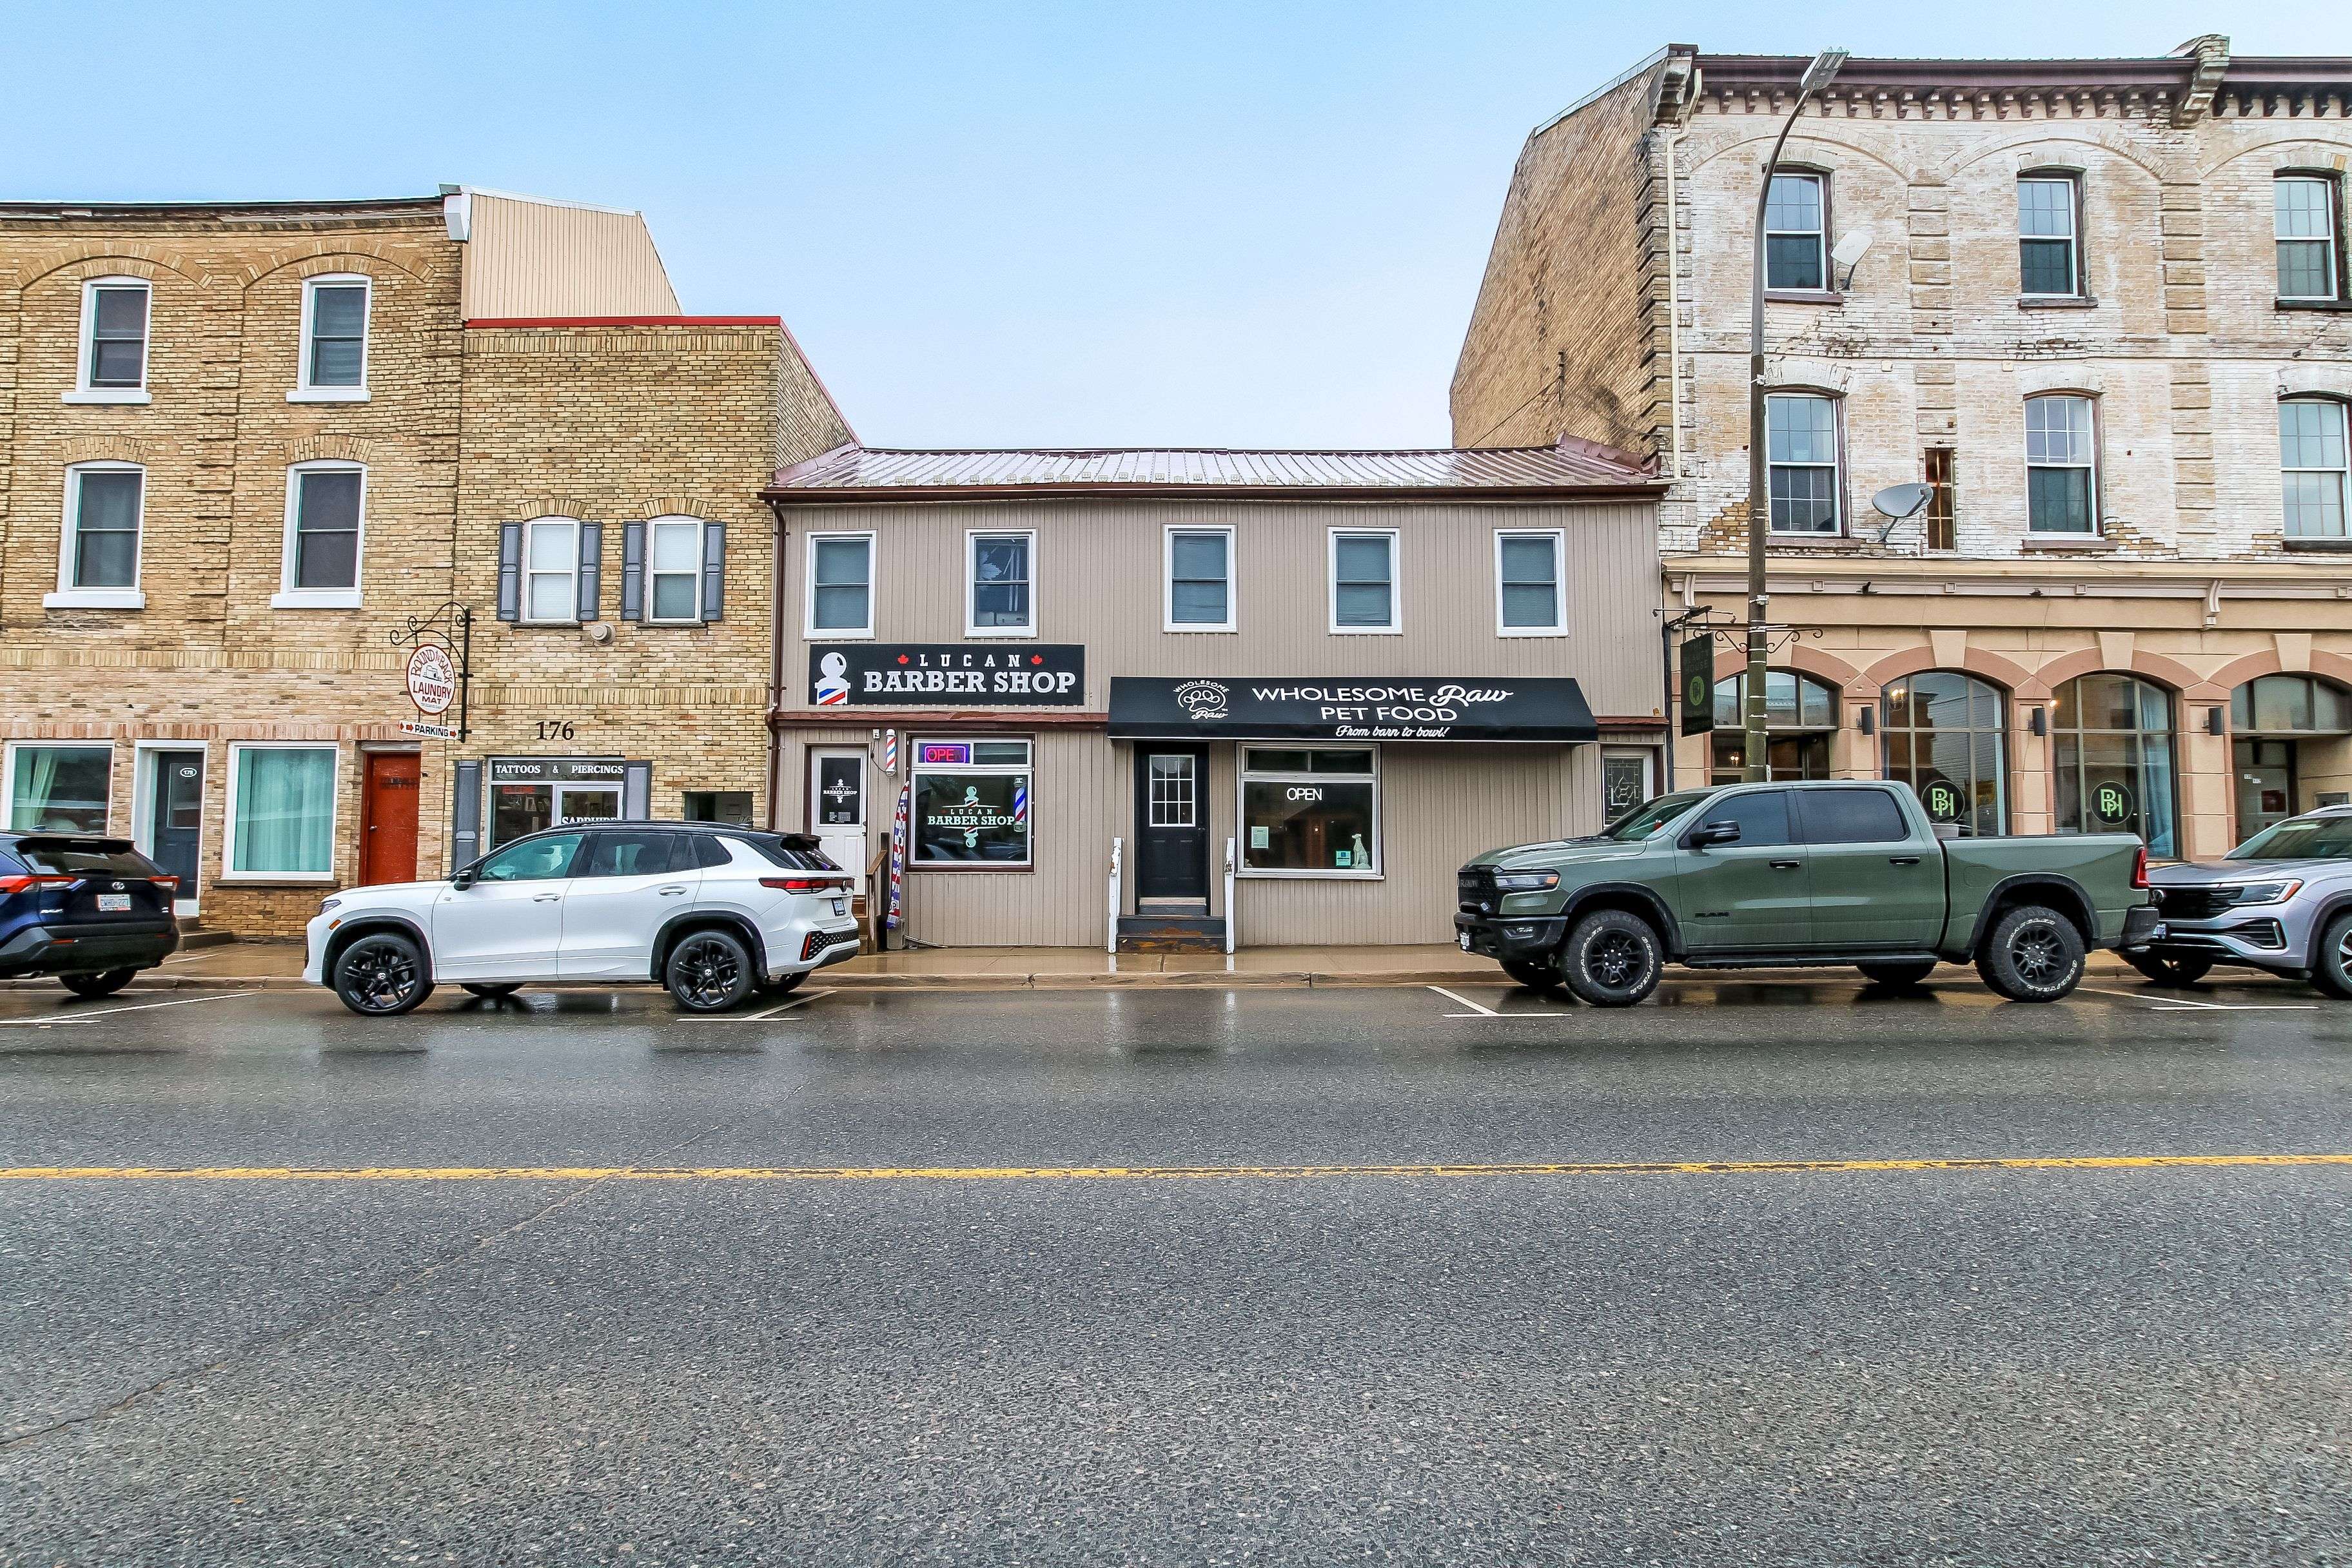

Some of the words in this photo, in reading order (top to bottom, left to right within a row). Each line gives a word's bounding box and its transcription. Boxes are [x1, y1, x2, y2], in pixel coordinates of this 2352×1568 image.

[410, 649, 435, 677] ROUND
[438, 655, 453, 685] BACK
[919, 654, 1021, 668] LUCAN
[863, 671, 987, 693] BARBER
[994, 671, 1076, 693] SHOP
[1173, 680, 1230, 694] WHOLESOME
[413, 680, 452, 700] LAUNDRY
[1252, 686, 1426, 702] WHOLESOME
[1429, 684, 1514, 707] Raw
[422, 696, 442, 705] MAT
[1191, 710, 1228, 720] Raw
[1320, 707, 1369, 720] PET
[1377, 706, 1458, 721] FOOD
[415, 724, 449, 737] PARKING
[536, 720, 574, 741] 176
[1335, 725, 1370, 738] From
[1373, 726, 1400, 737] barn
[1402, 727, 1416, 737] to
[1416, 727, 1450, 738] bowl!
[495, 765, 541, 774] TATTOOS
[552, 765, 559, 774] &
[571, 765, 624, 774] PIERCINGS
[1286, 787, 1322, 801] OPEN
[927, 816, 979, 825] BARBER
[981, 816, 1015, 825] SHOP
[2006, 918, 2055, 948] WRANGLER
[1580, 926, 1603, 983] WRANGLER
[1630, 936, 1654, 994] GOODYEAR
[2026, 959, 2077, 992] GOODYEAR
